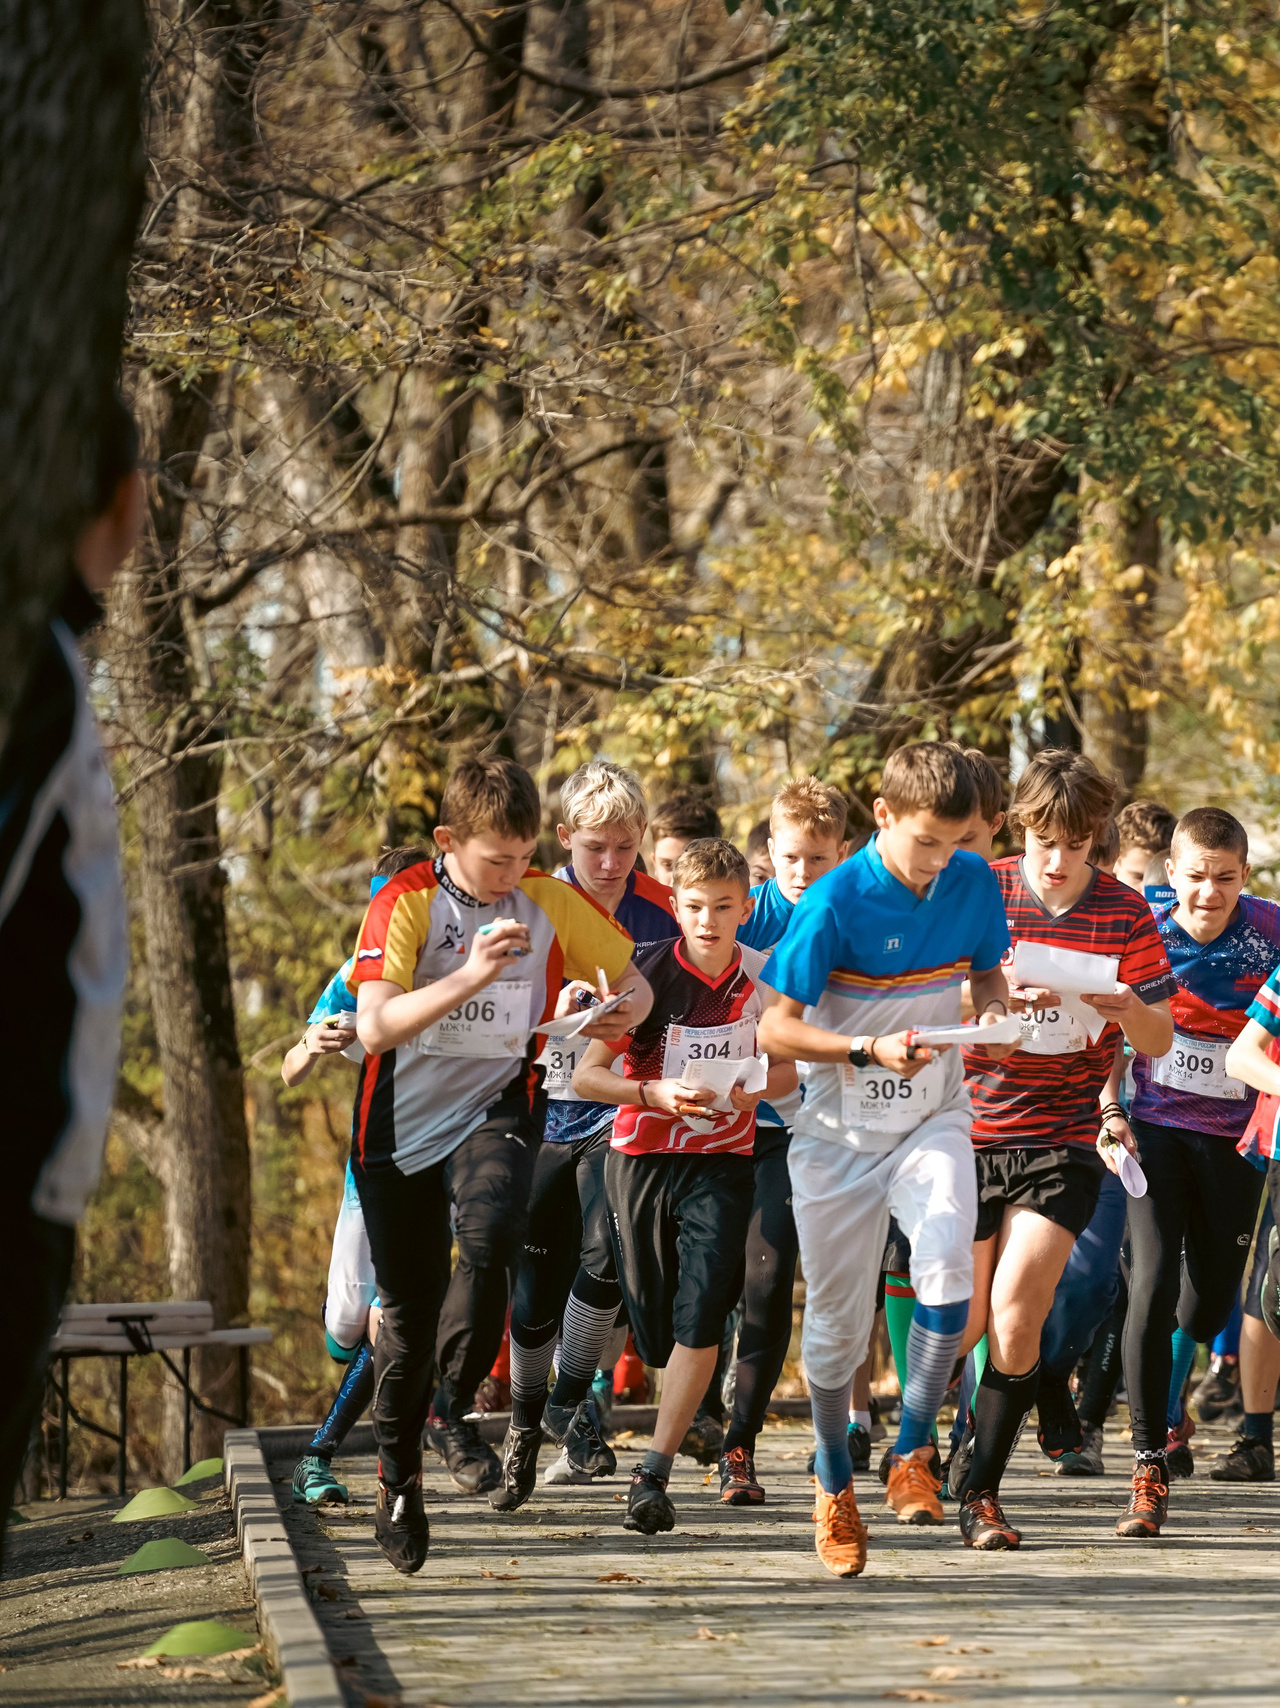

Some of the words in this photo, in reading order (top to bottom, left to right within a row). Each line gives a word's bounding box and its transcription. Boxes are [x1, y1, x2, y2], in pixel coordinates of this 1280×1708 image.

[448, 1001, 495, 1022] 306
[504, 1011, 510, 1025] 1
[440, 1022, 472, 1032] МЖ14
[688, 1041, 731, 1060] 304
[737, 1045, 742, 1057] 1
[551, 1051, 583, 1070] 31
[1175, 1050, 1214, 1075] 309
[1168, 1064, 1194, 1080] МЖ14
[865, 1079, 912, 1100] 305
[922, 1087, 927, 1101] 1
